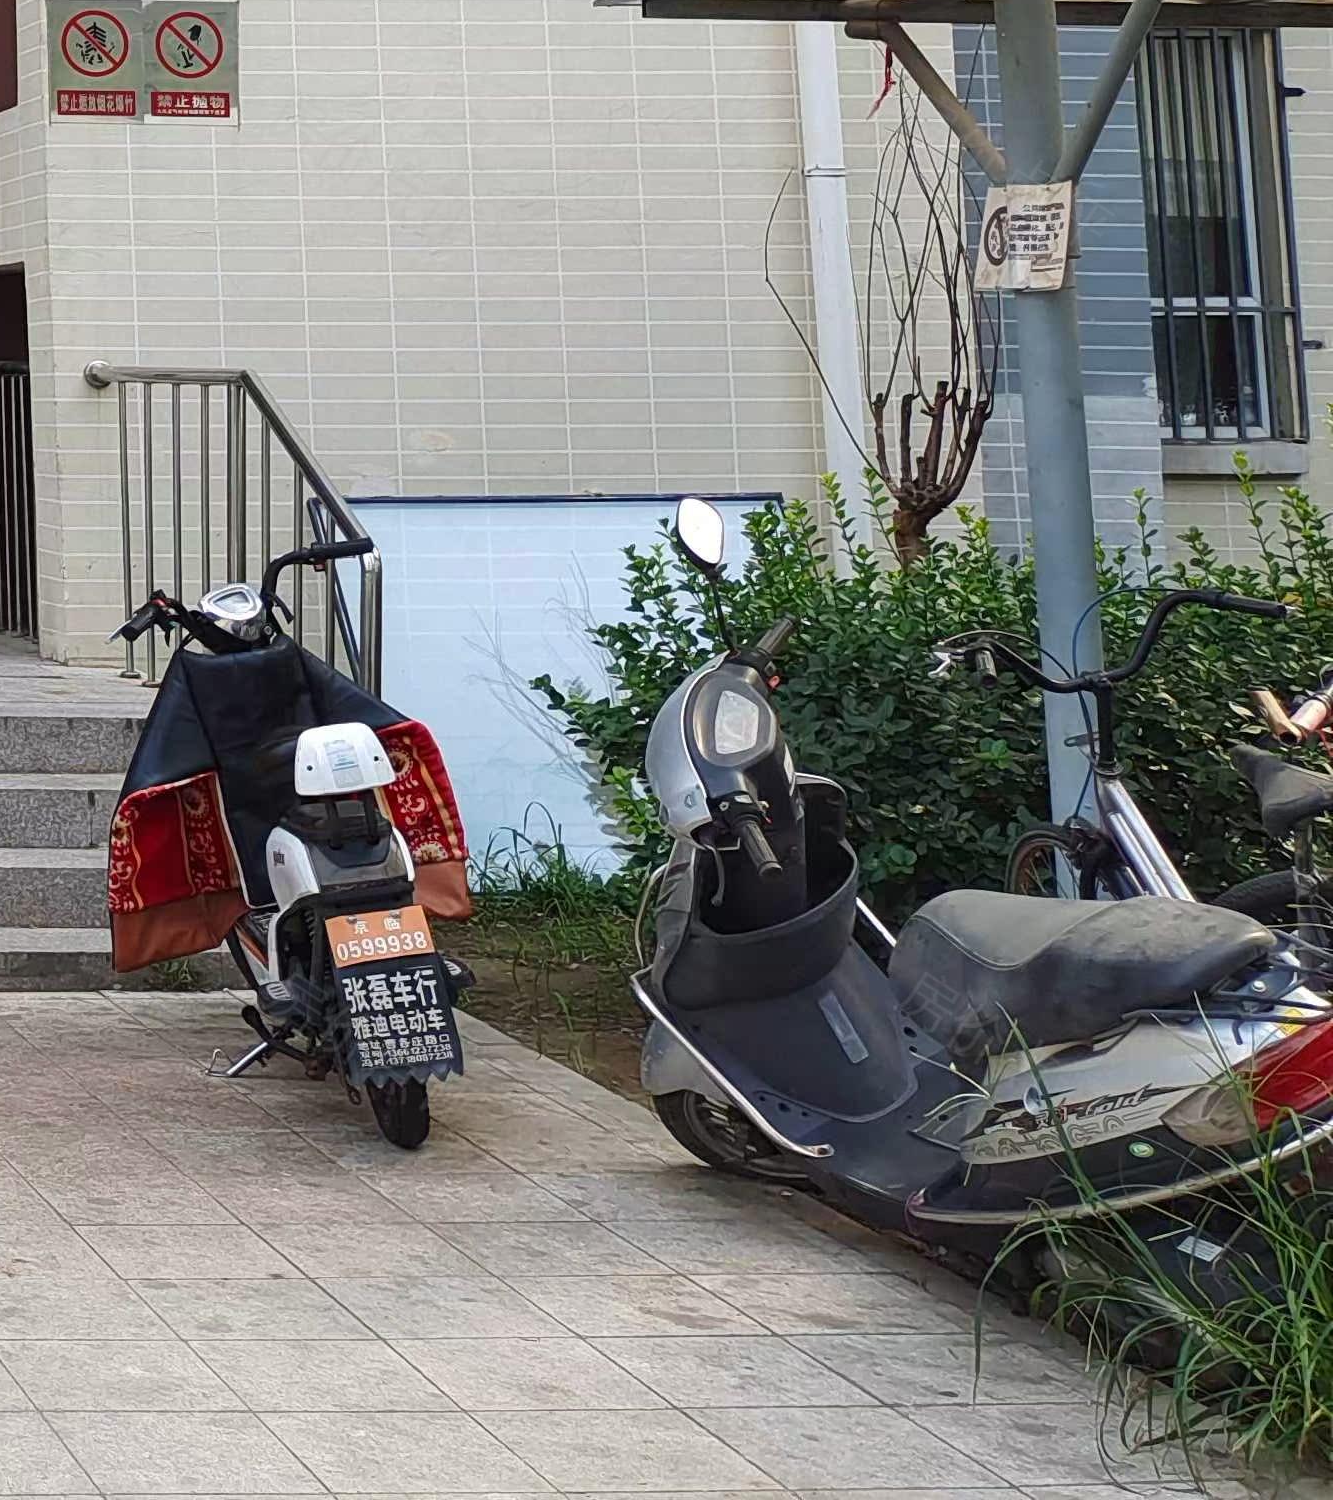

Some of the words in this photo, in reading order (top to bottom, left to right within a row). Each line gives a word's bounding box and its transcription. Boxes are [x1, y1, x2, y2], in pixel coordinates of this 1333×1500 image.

[336, 931, 427, 961] 0599938
[342, 969, 438, 1014] 张磊车行
[351, 1007, 446, 1040] 雅迪电动车
